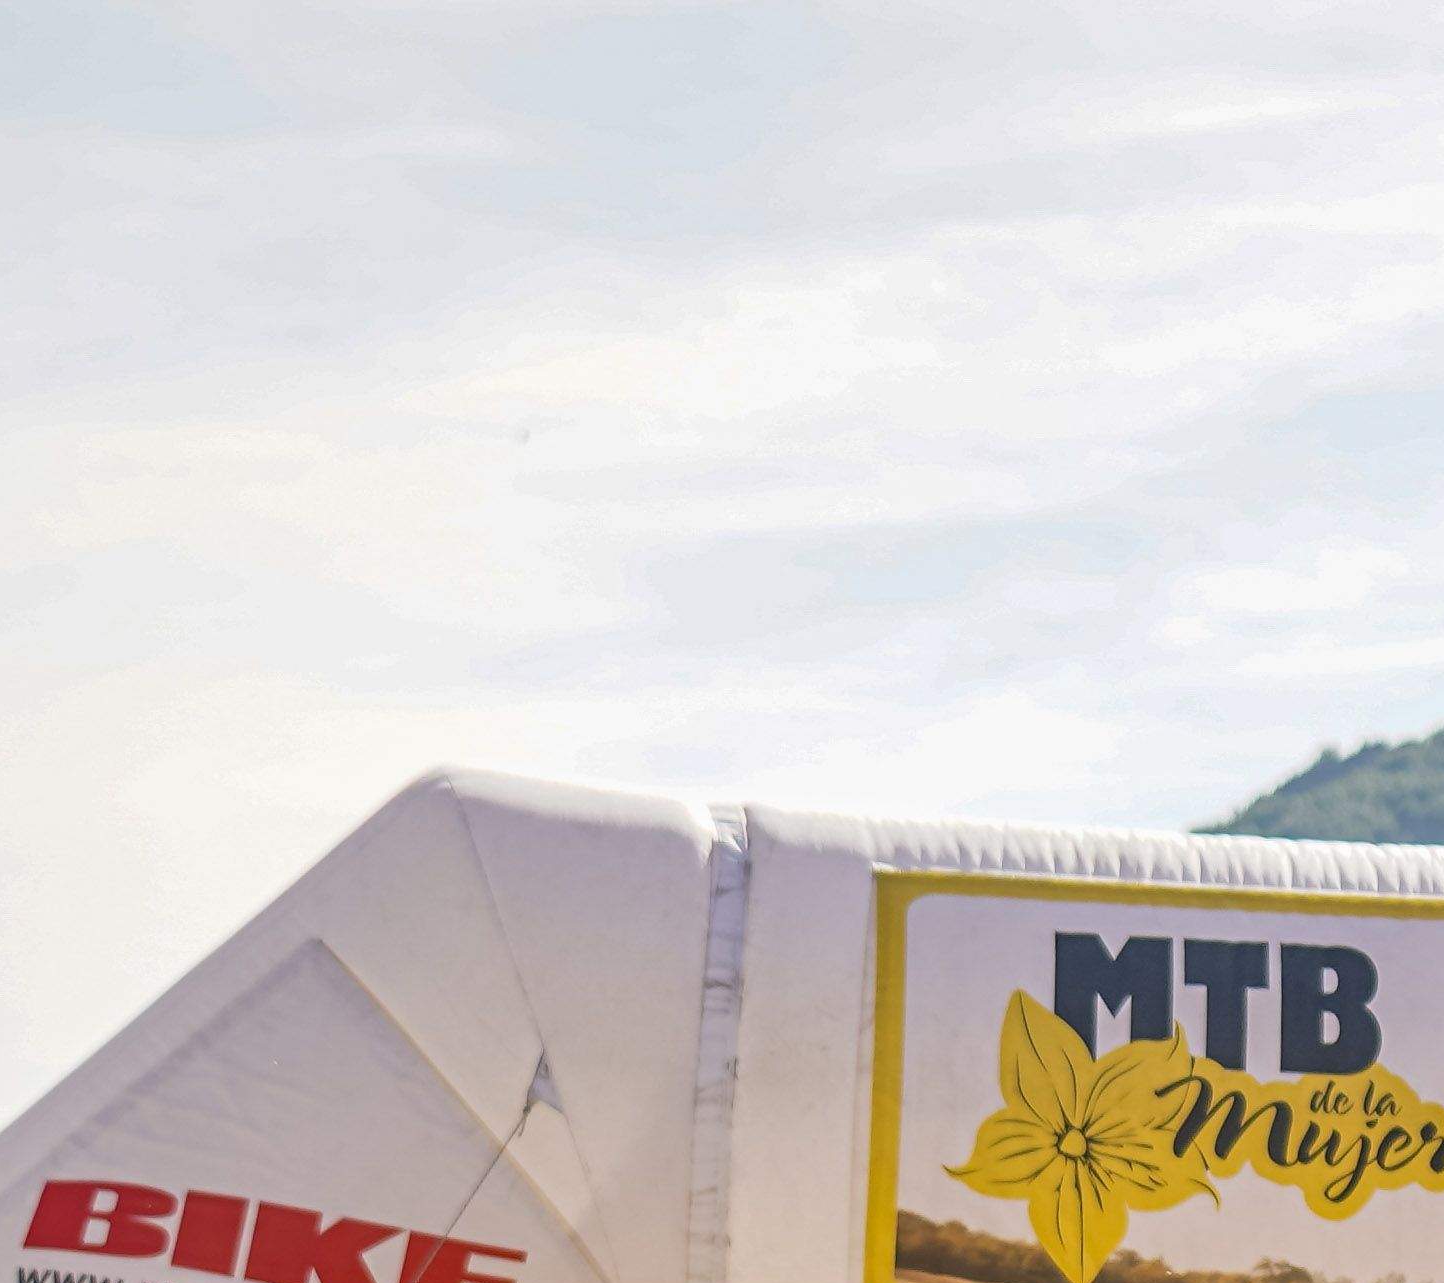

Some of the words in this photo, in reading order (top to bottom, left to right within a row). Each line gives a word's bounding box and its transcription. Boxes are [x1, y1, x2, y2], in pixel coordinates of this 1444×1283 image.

[1055, 931, 1383, 1075] MTB
[1311, 1080, 1351, 1116] de
[1363, 1080, 1402, 1118] la
